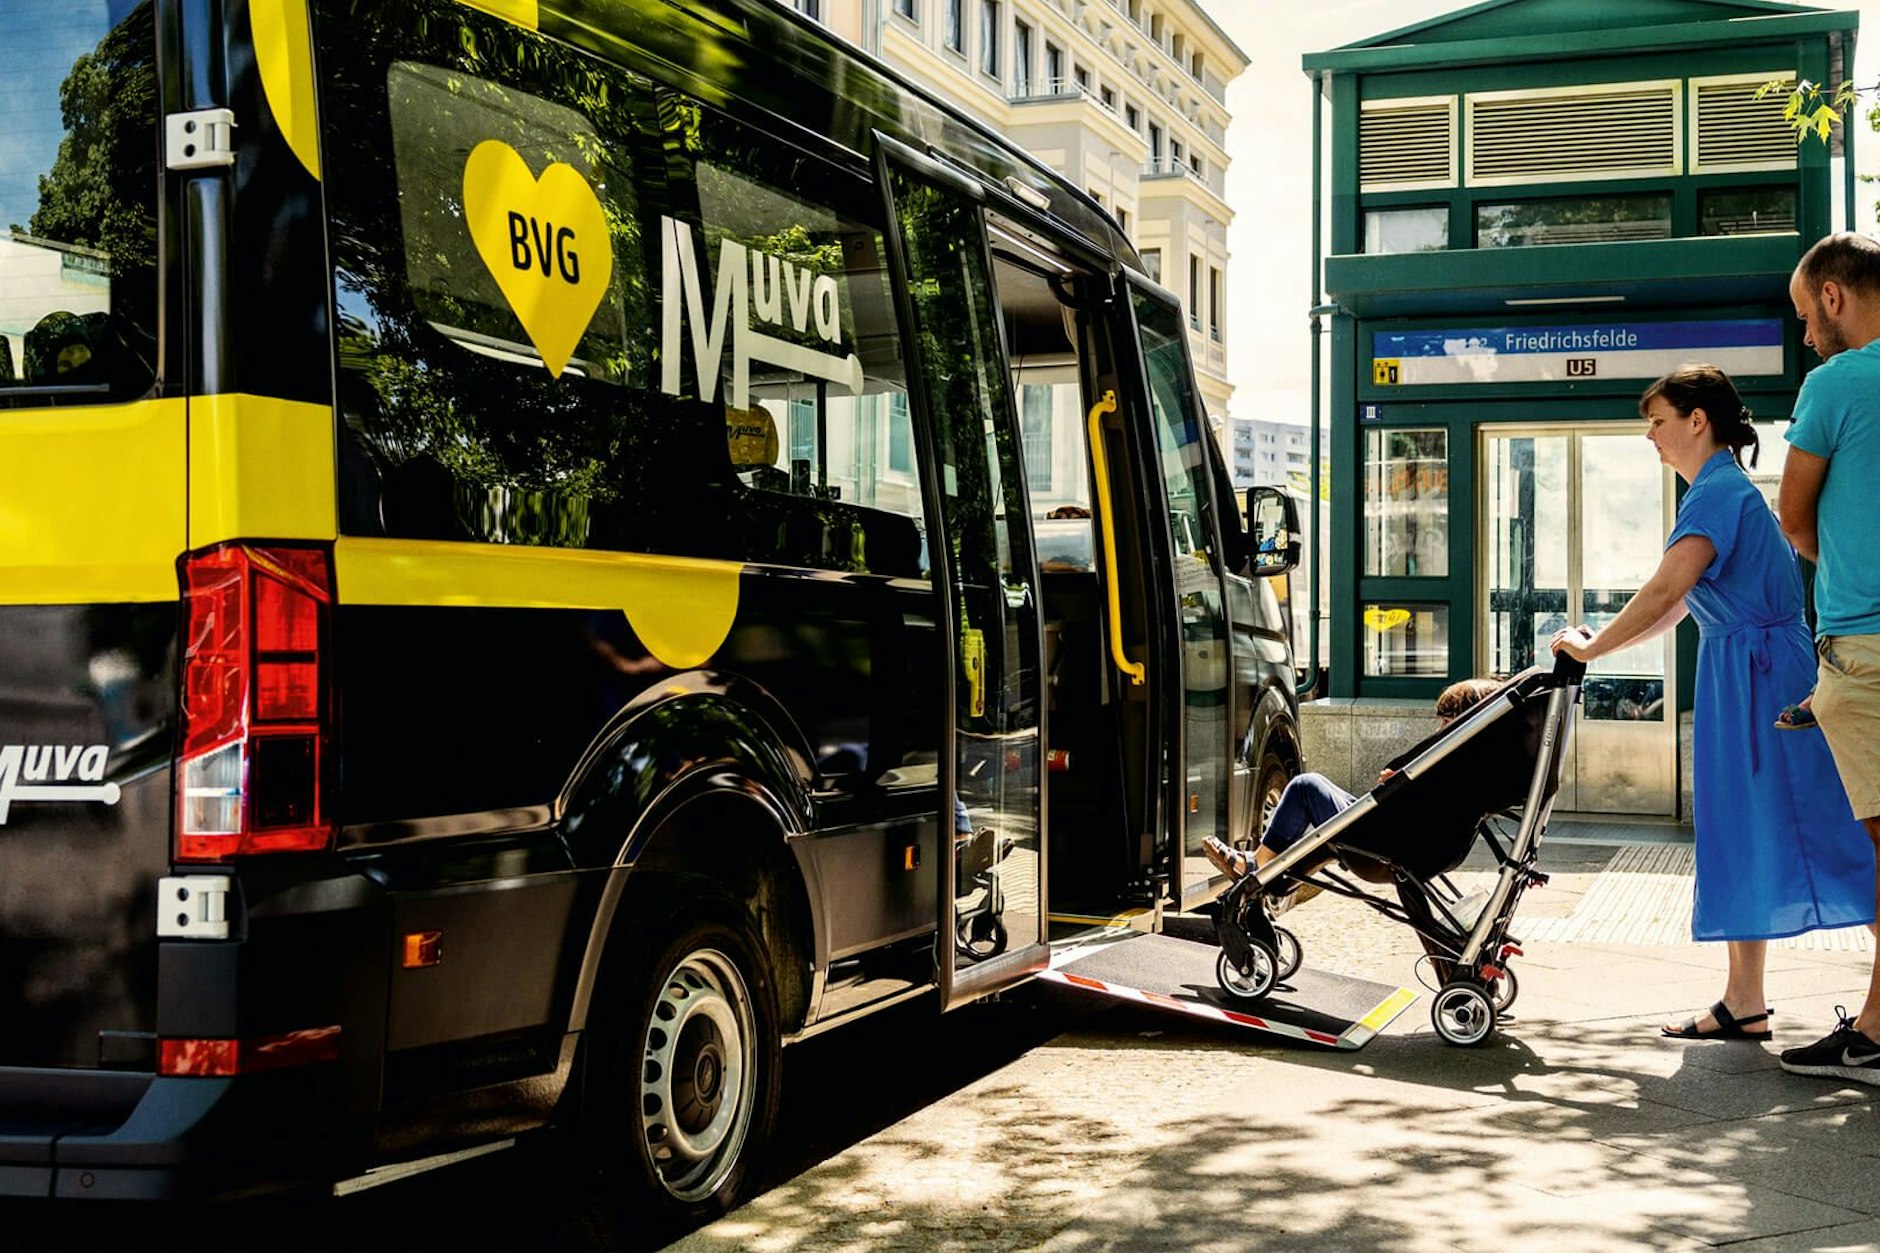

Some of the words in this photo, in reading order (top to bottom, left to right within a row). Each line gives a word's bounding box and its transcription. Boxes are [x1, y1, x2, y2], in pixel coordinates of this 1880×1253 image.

[508, 210, 580, 285] BVG
[660, 214, 864, 411] Muva
[1505, 329, 1638, 350] Friedrichsfelde
[1569, 360, 1595, 375] U5
